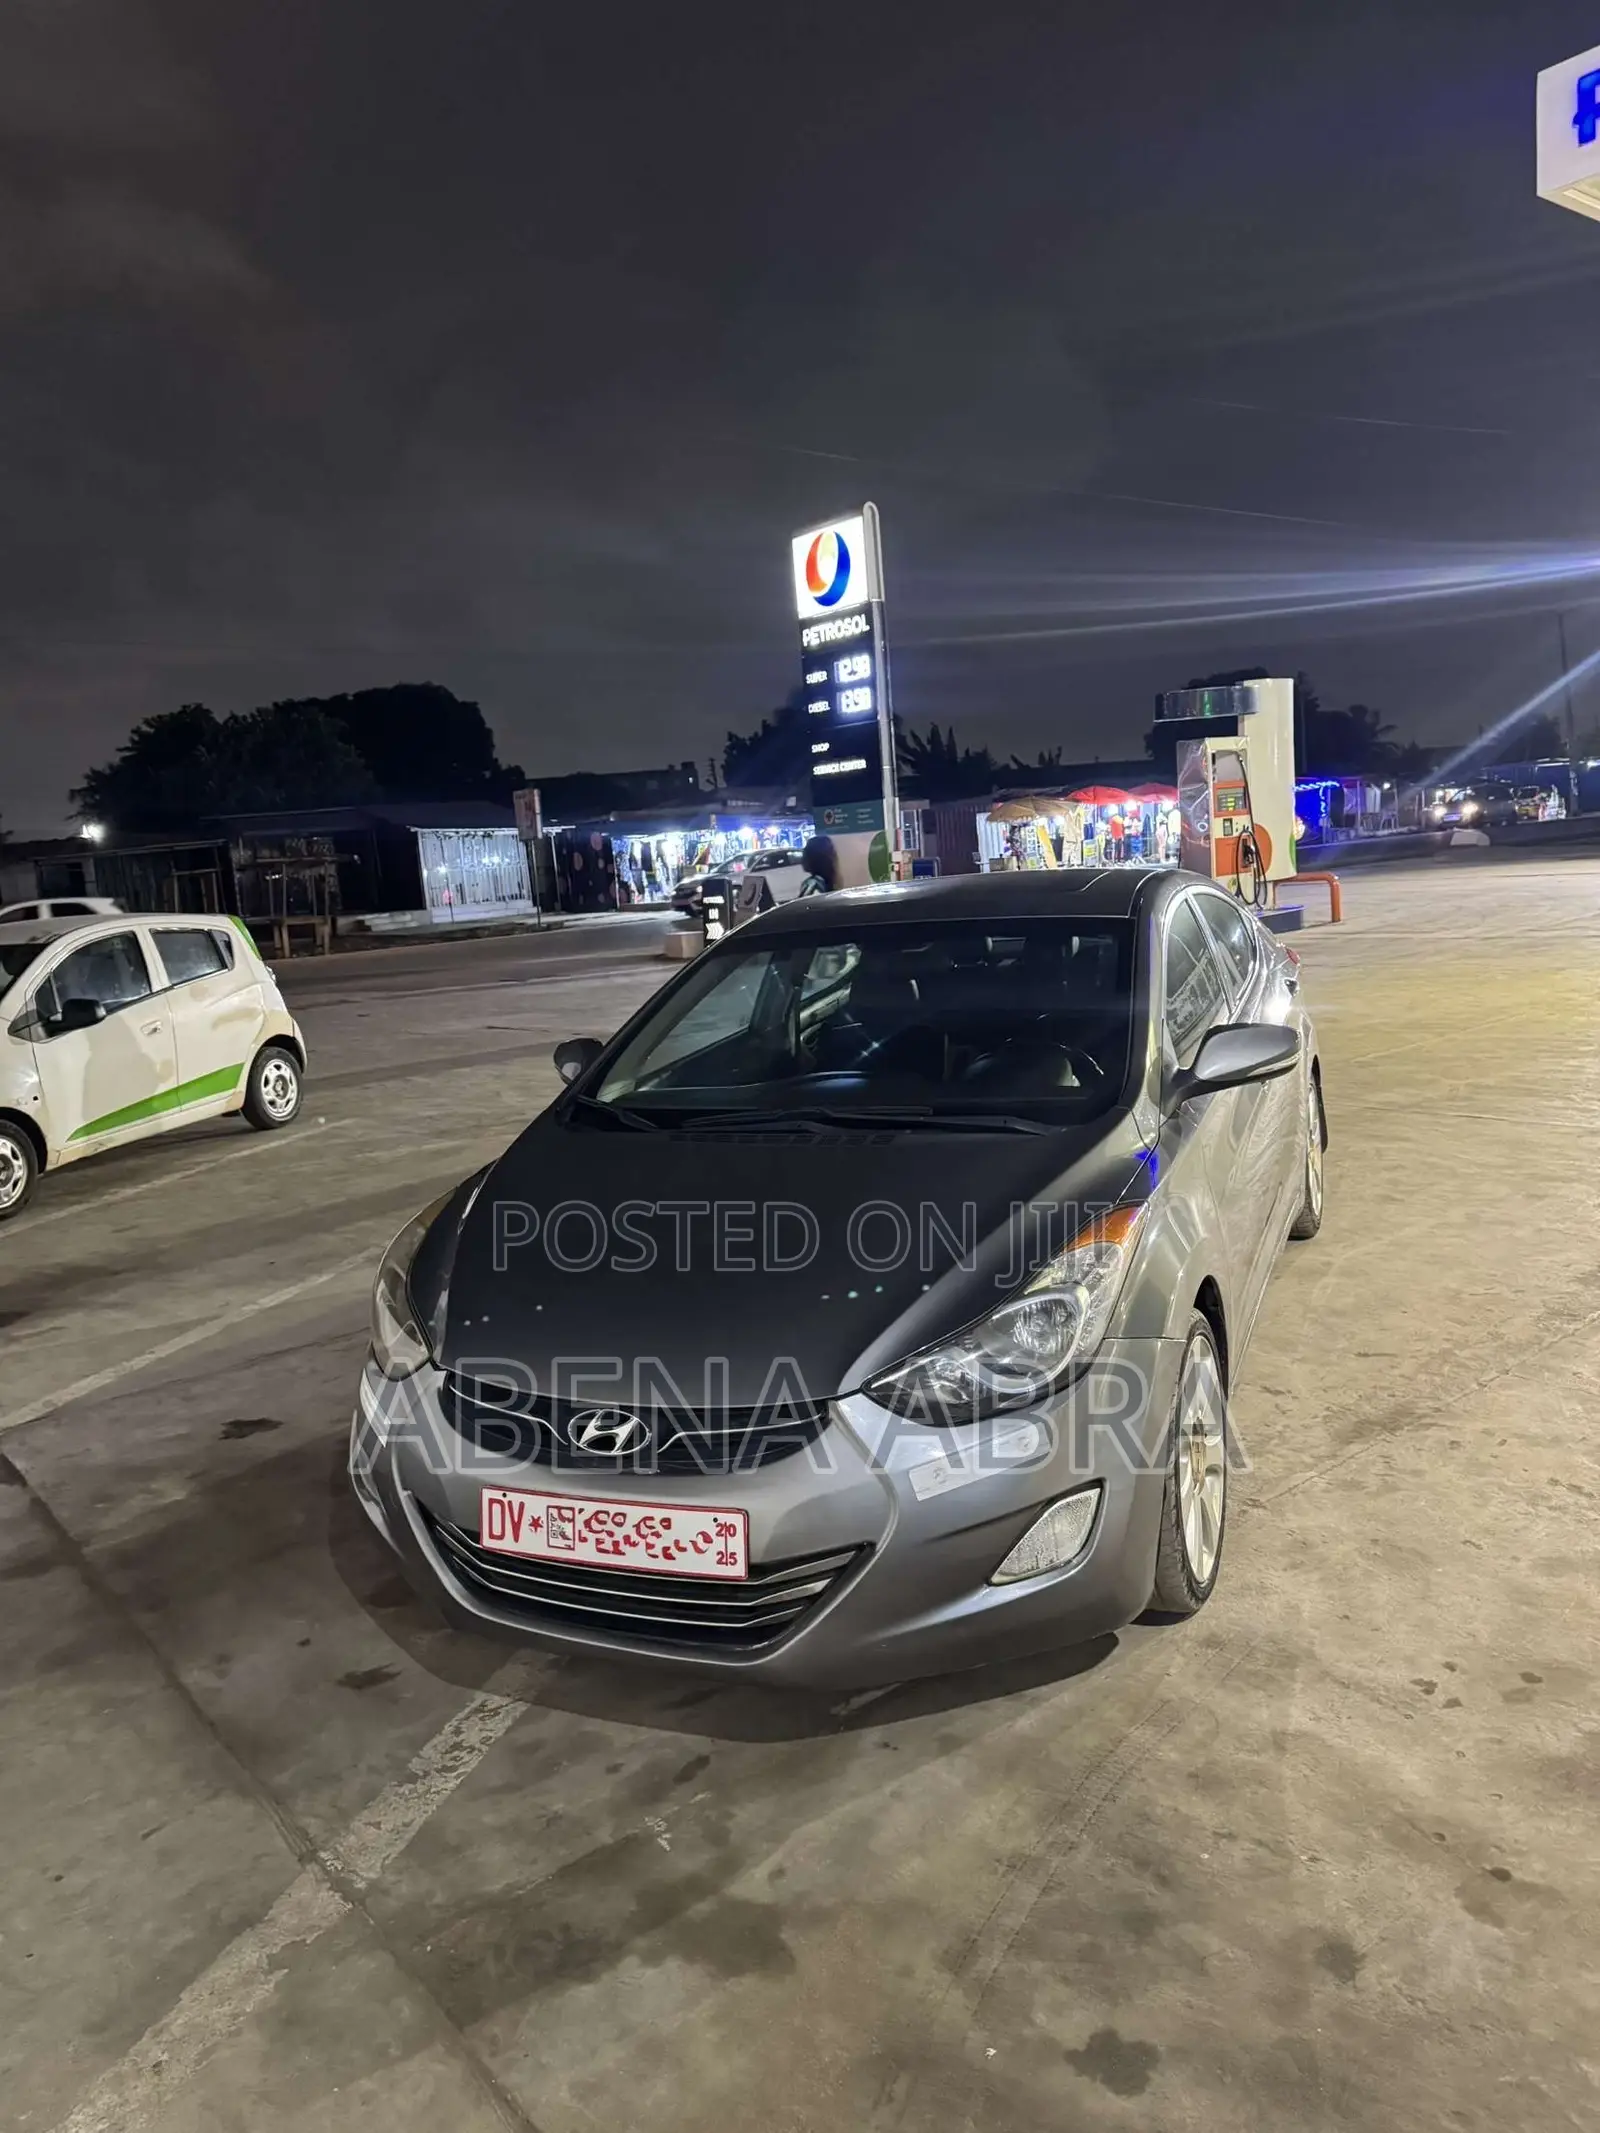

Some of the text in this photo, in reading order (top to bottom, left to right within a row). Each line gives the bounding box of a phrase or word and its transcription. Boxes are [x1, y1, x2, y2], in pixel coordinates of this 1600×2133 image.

[803, 613, 870, 647] PETROSOL
[487, 1498, 525, 1543] DV
[715, 1521, 737, 1537] 20
[716, 1550, 738, 1566] 25
